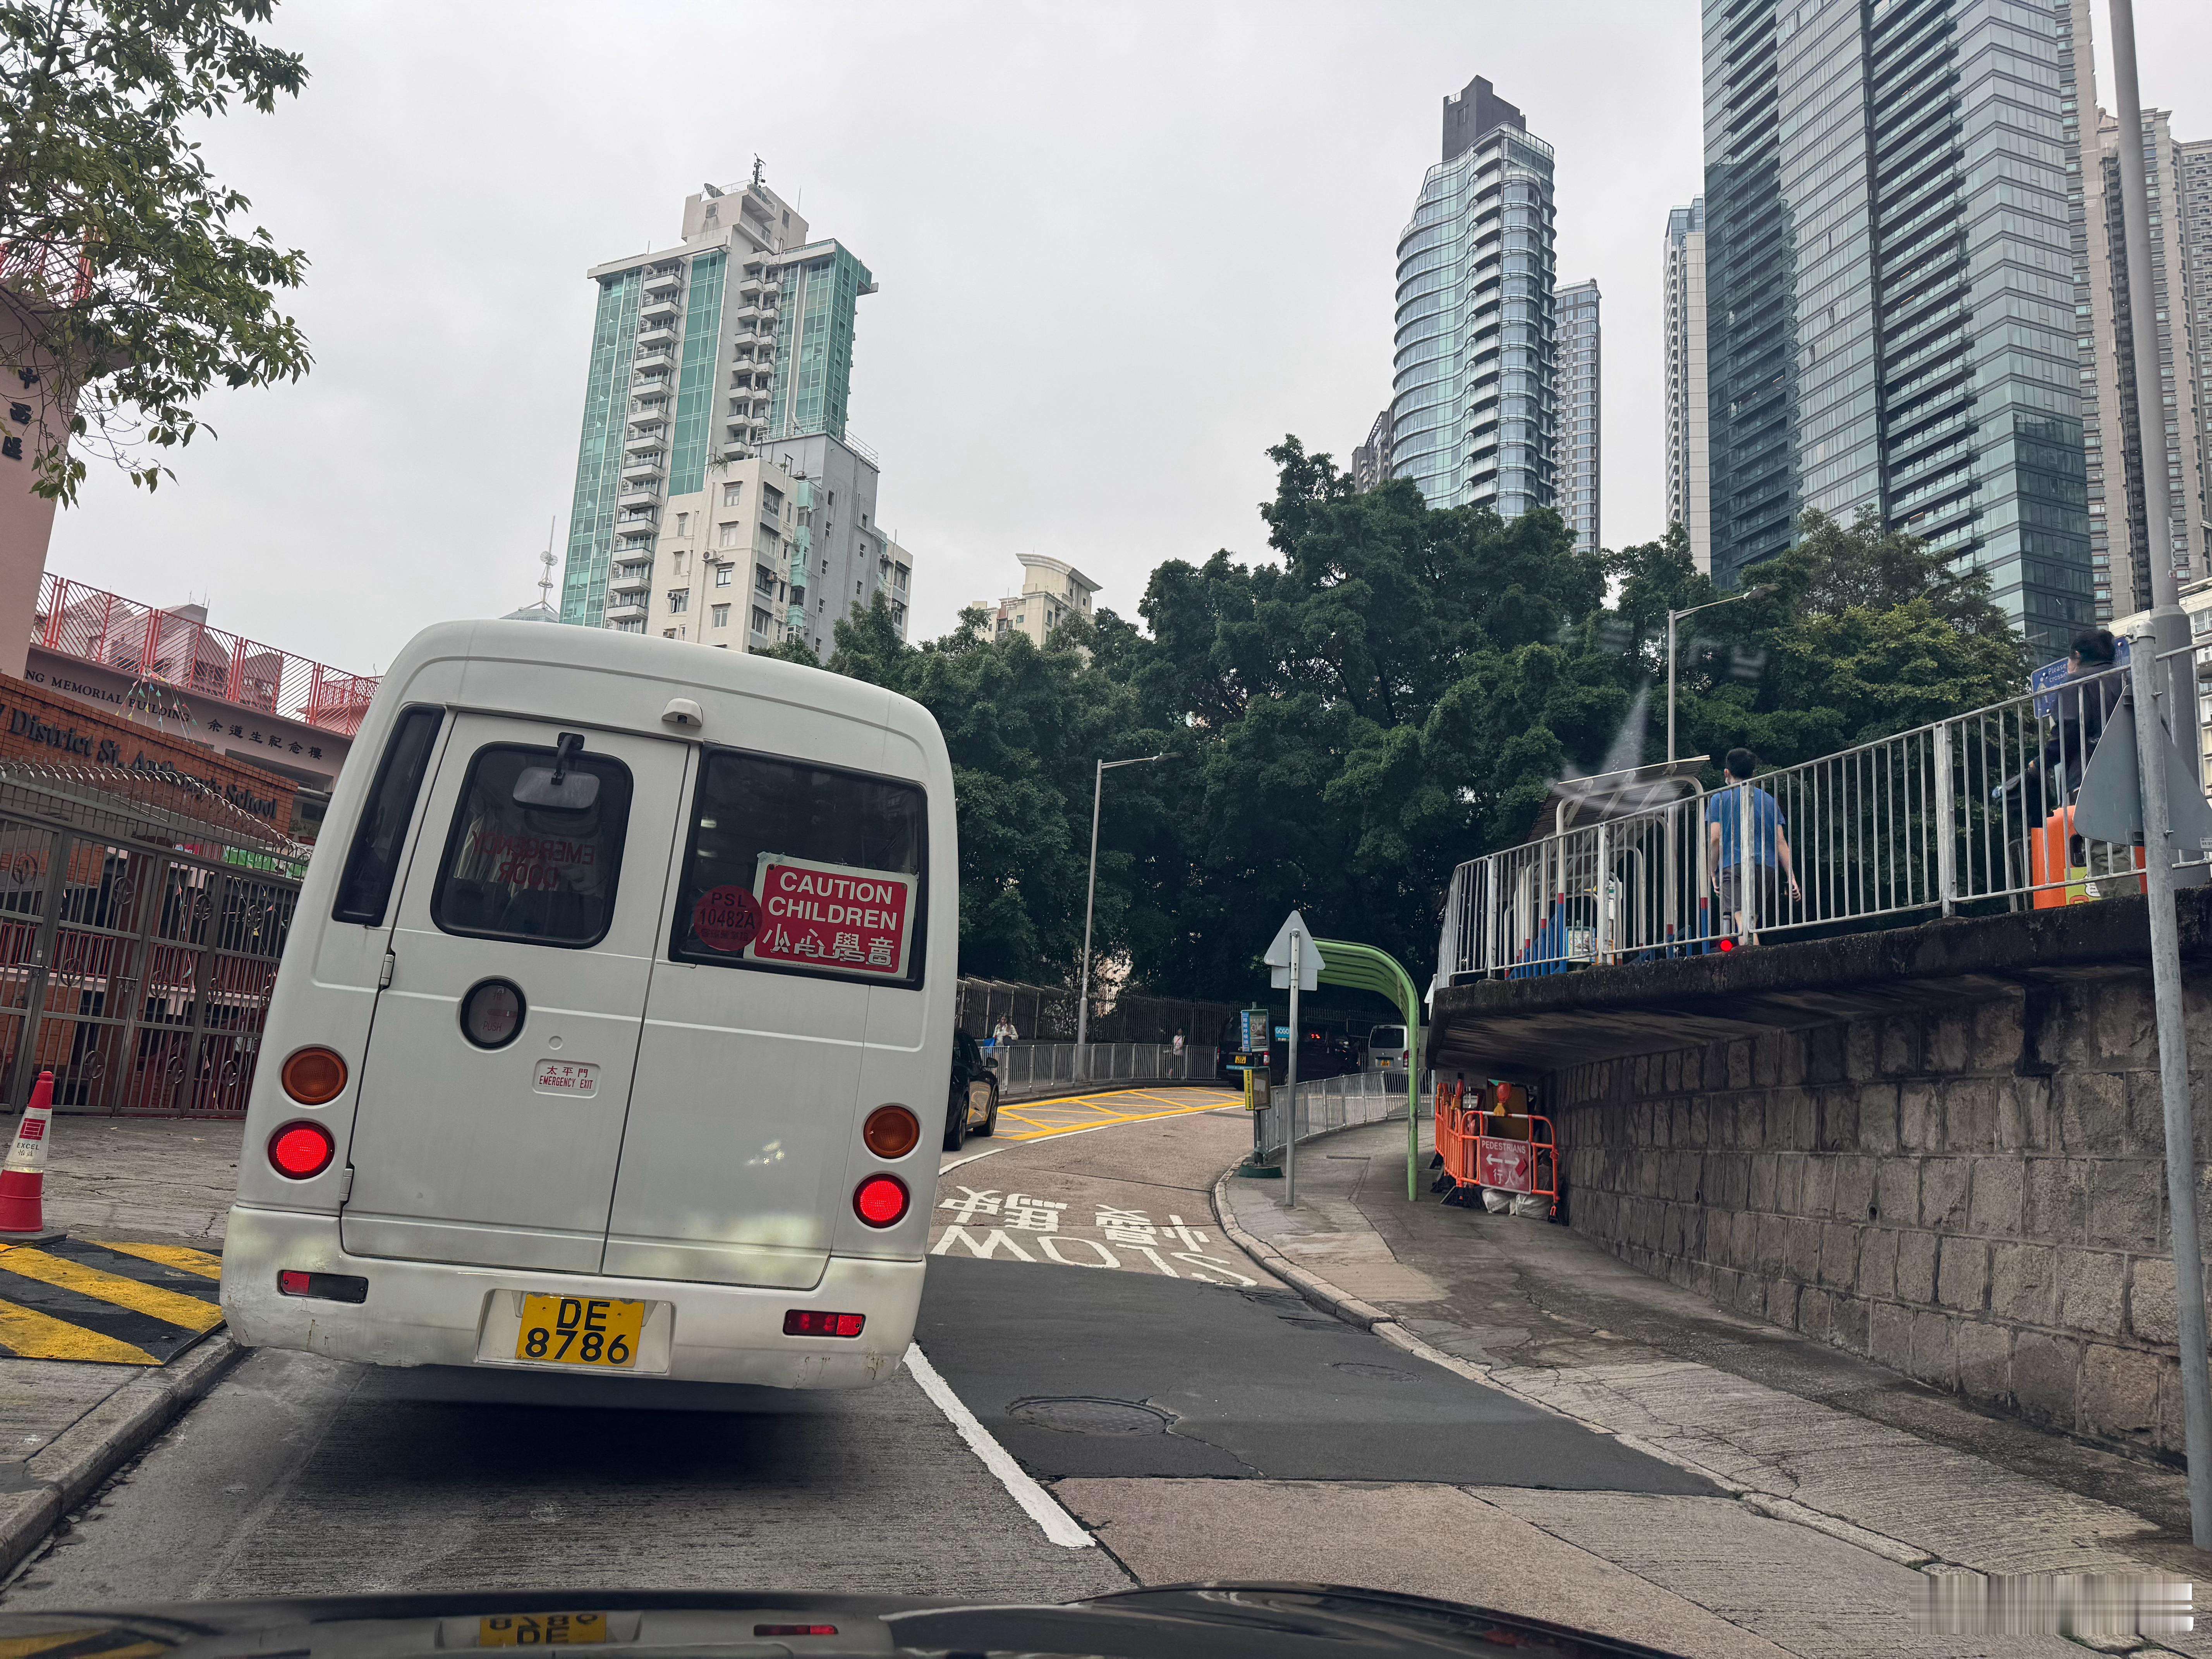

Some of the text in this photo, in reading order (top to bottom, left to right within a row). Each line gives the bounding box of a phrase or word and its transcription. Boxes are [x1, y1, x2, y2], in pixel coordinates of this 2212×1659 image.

[2048, 663, 2067, 675] Please
[2049, 670, 2069, 682] crossin
[51, 677, 123, 704] MEMORIAL
[129, 698, 189, 722] BUILDING
[207, 719, 322, 760] 余道生紀念樓
[10, 708, 94, 756] District
[226, 783, 278, 819] School
[711, 892, 746, 908] PSL
[780, 872, 892, 905] CAUTION
[700, 908, 755, 929] 10482A
[768, 896, 897, 931] CHILDREN
[793, 943, 891, 966] FUSO
[483, 1021, 502, 1032] PUSH
[539, 1075, 593, 1089] EMERGENCY EXIT
[547, 1066, 588, 1078] 太平門
[1482, 1140, 1526, 1154] PEDESTRIANS
[1493, 1168, 1514, 1185] 行人
[938, 1186, 1210, 1252] 慢駛
[931, 1225, 1258, 1286] SLOW
[556, 1298, 610, 1331] DE
[525, 1327, 629, 1364] 8786
